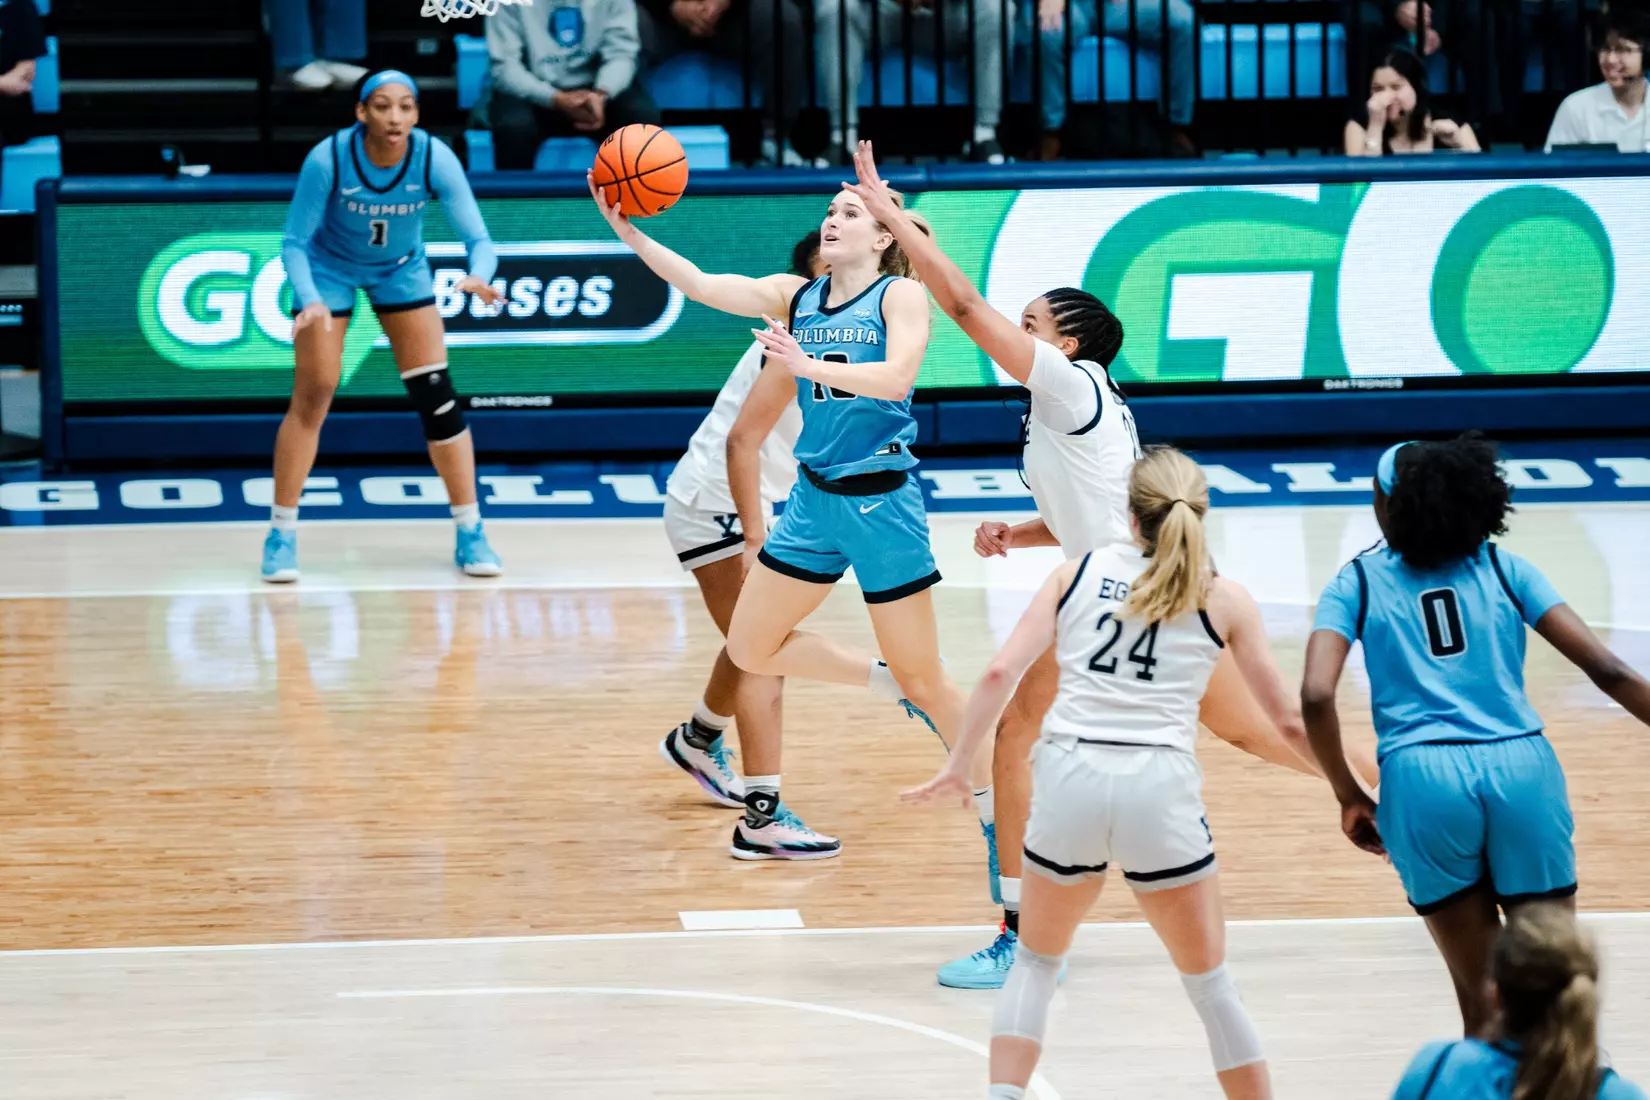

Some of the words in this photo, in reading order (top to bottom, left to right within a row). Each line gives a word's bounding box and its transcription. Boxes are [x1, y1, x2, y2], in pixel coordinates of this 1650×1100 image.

[368, 219, 388, 247] 1
[433, 268, 614, 319] Buses
[713, 513, 741, 538] Y
[1088, 612, 1161, 681] 24
[1417, 587, 1468, 659] 0
